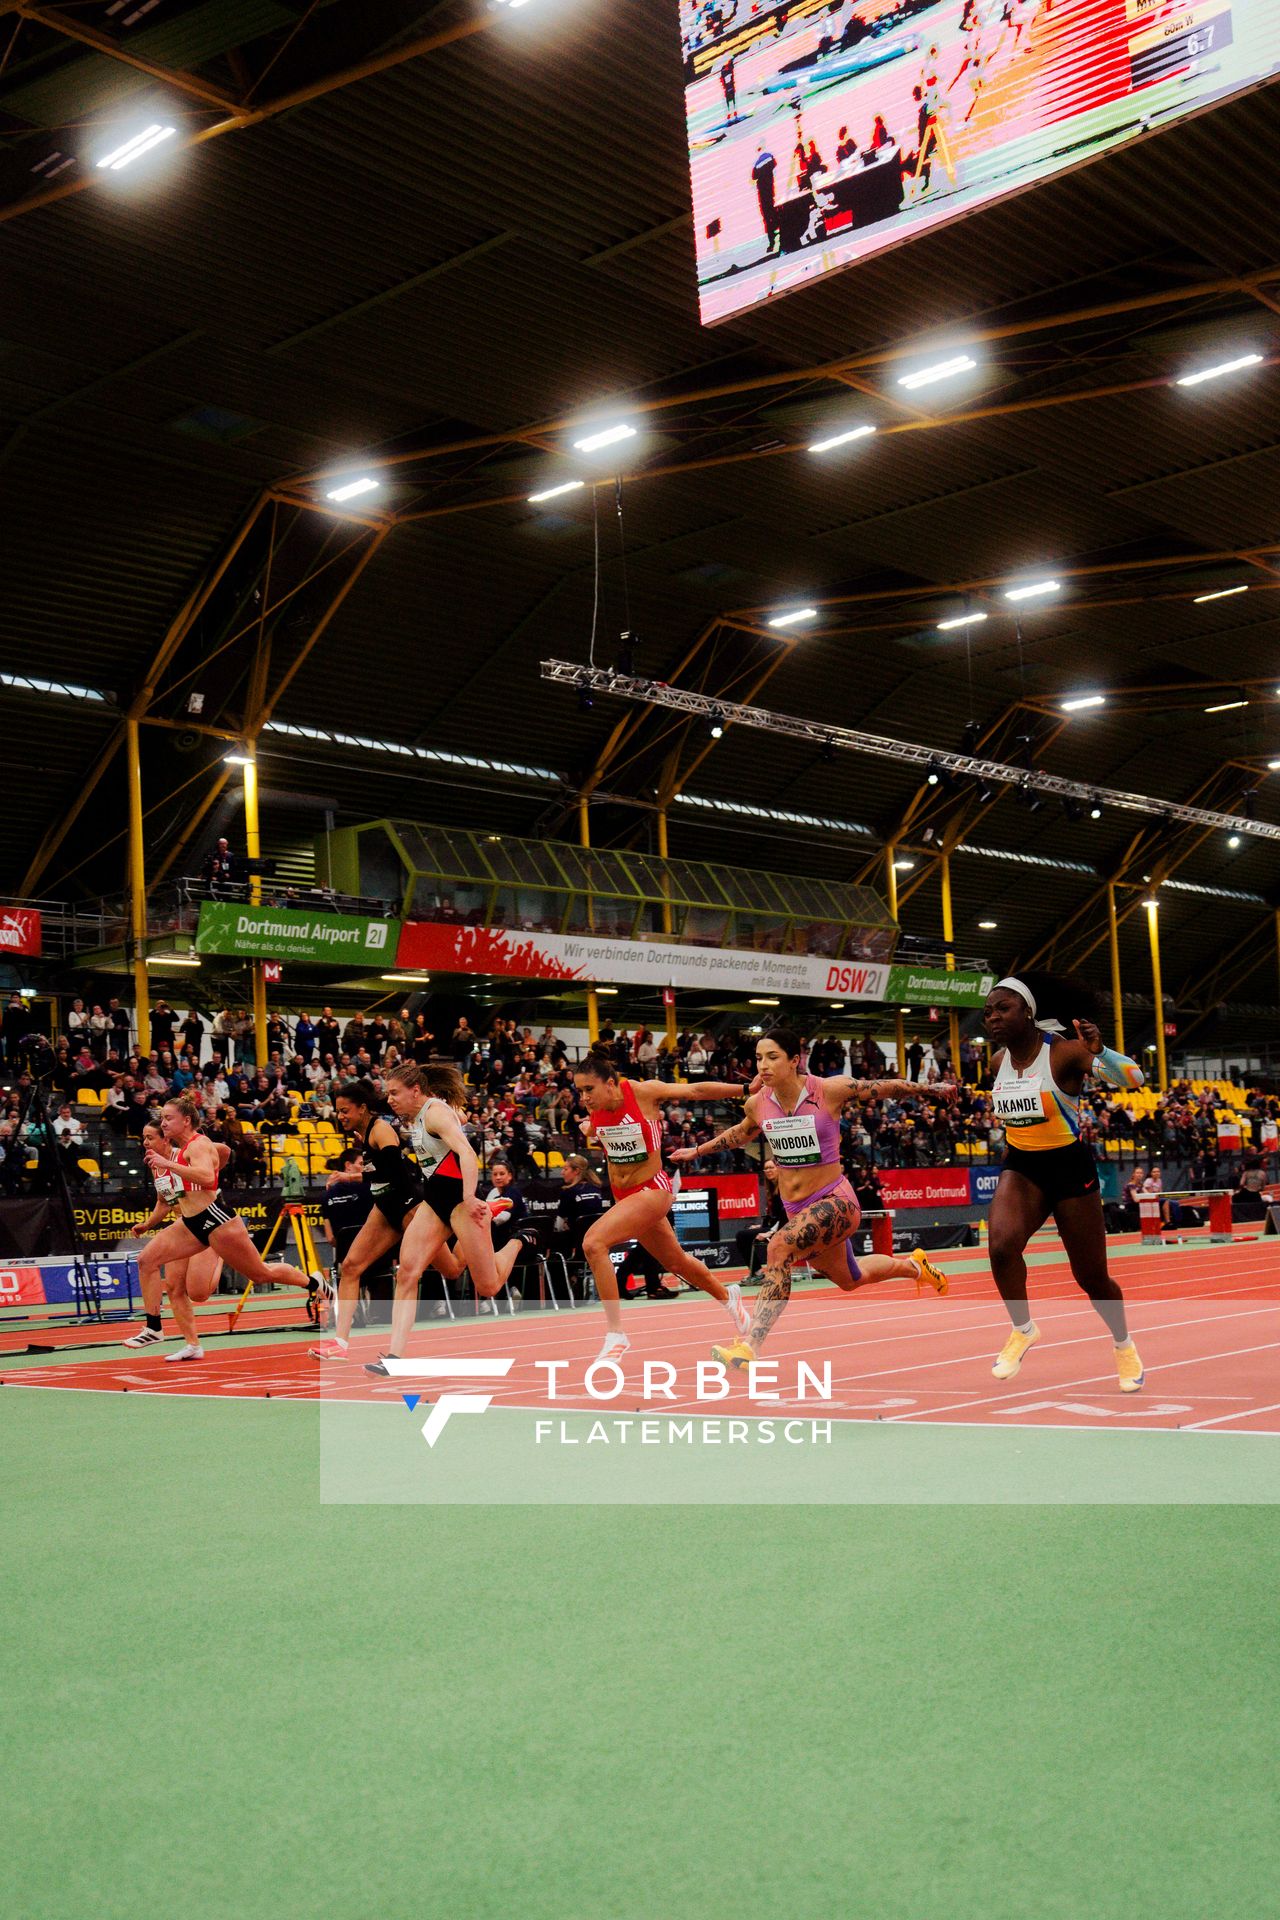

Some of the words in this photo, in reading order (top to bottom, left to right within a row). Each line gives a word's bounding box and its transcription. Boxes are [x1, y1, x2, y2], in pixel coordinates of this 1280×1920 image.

[237, 916, 310, 939] Dortmund
[311, 923, 360, 945] Airport
[368, 929, 382, 945] 21
[235, 940, 260, 950] Näher
[261, 942, 273, 951] als
[275, 943, 286, 952] du
[564, 943, 584, 958] Wir
[587, 946, 644, 962] verbinden
[647, 949, 708, 968] Dortmunds
[709, 957, 760, 971] packende
[762, 959, 808, 976] Momente
[265, 963, 279, 979] M
[826, 966, 882, 995] DSW21
[907, 974, 949, 992] Dortmund
[950, 976, 977, 996] Airport
[665, 990, 673, 1003] L
[997, 1097, 1039, 1114] AKANDE
[769, 1134, 816, 1150] SWOBODA
[881, 1186, 923, 1203] Sparkasse
[926, 1184, 967, 1199] Dortmund
[533, 1201, 545, 1210] the
[717, 1194, 756, 1210] rtmund
[694, 1247, 718, 1257] Meeting
